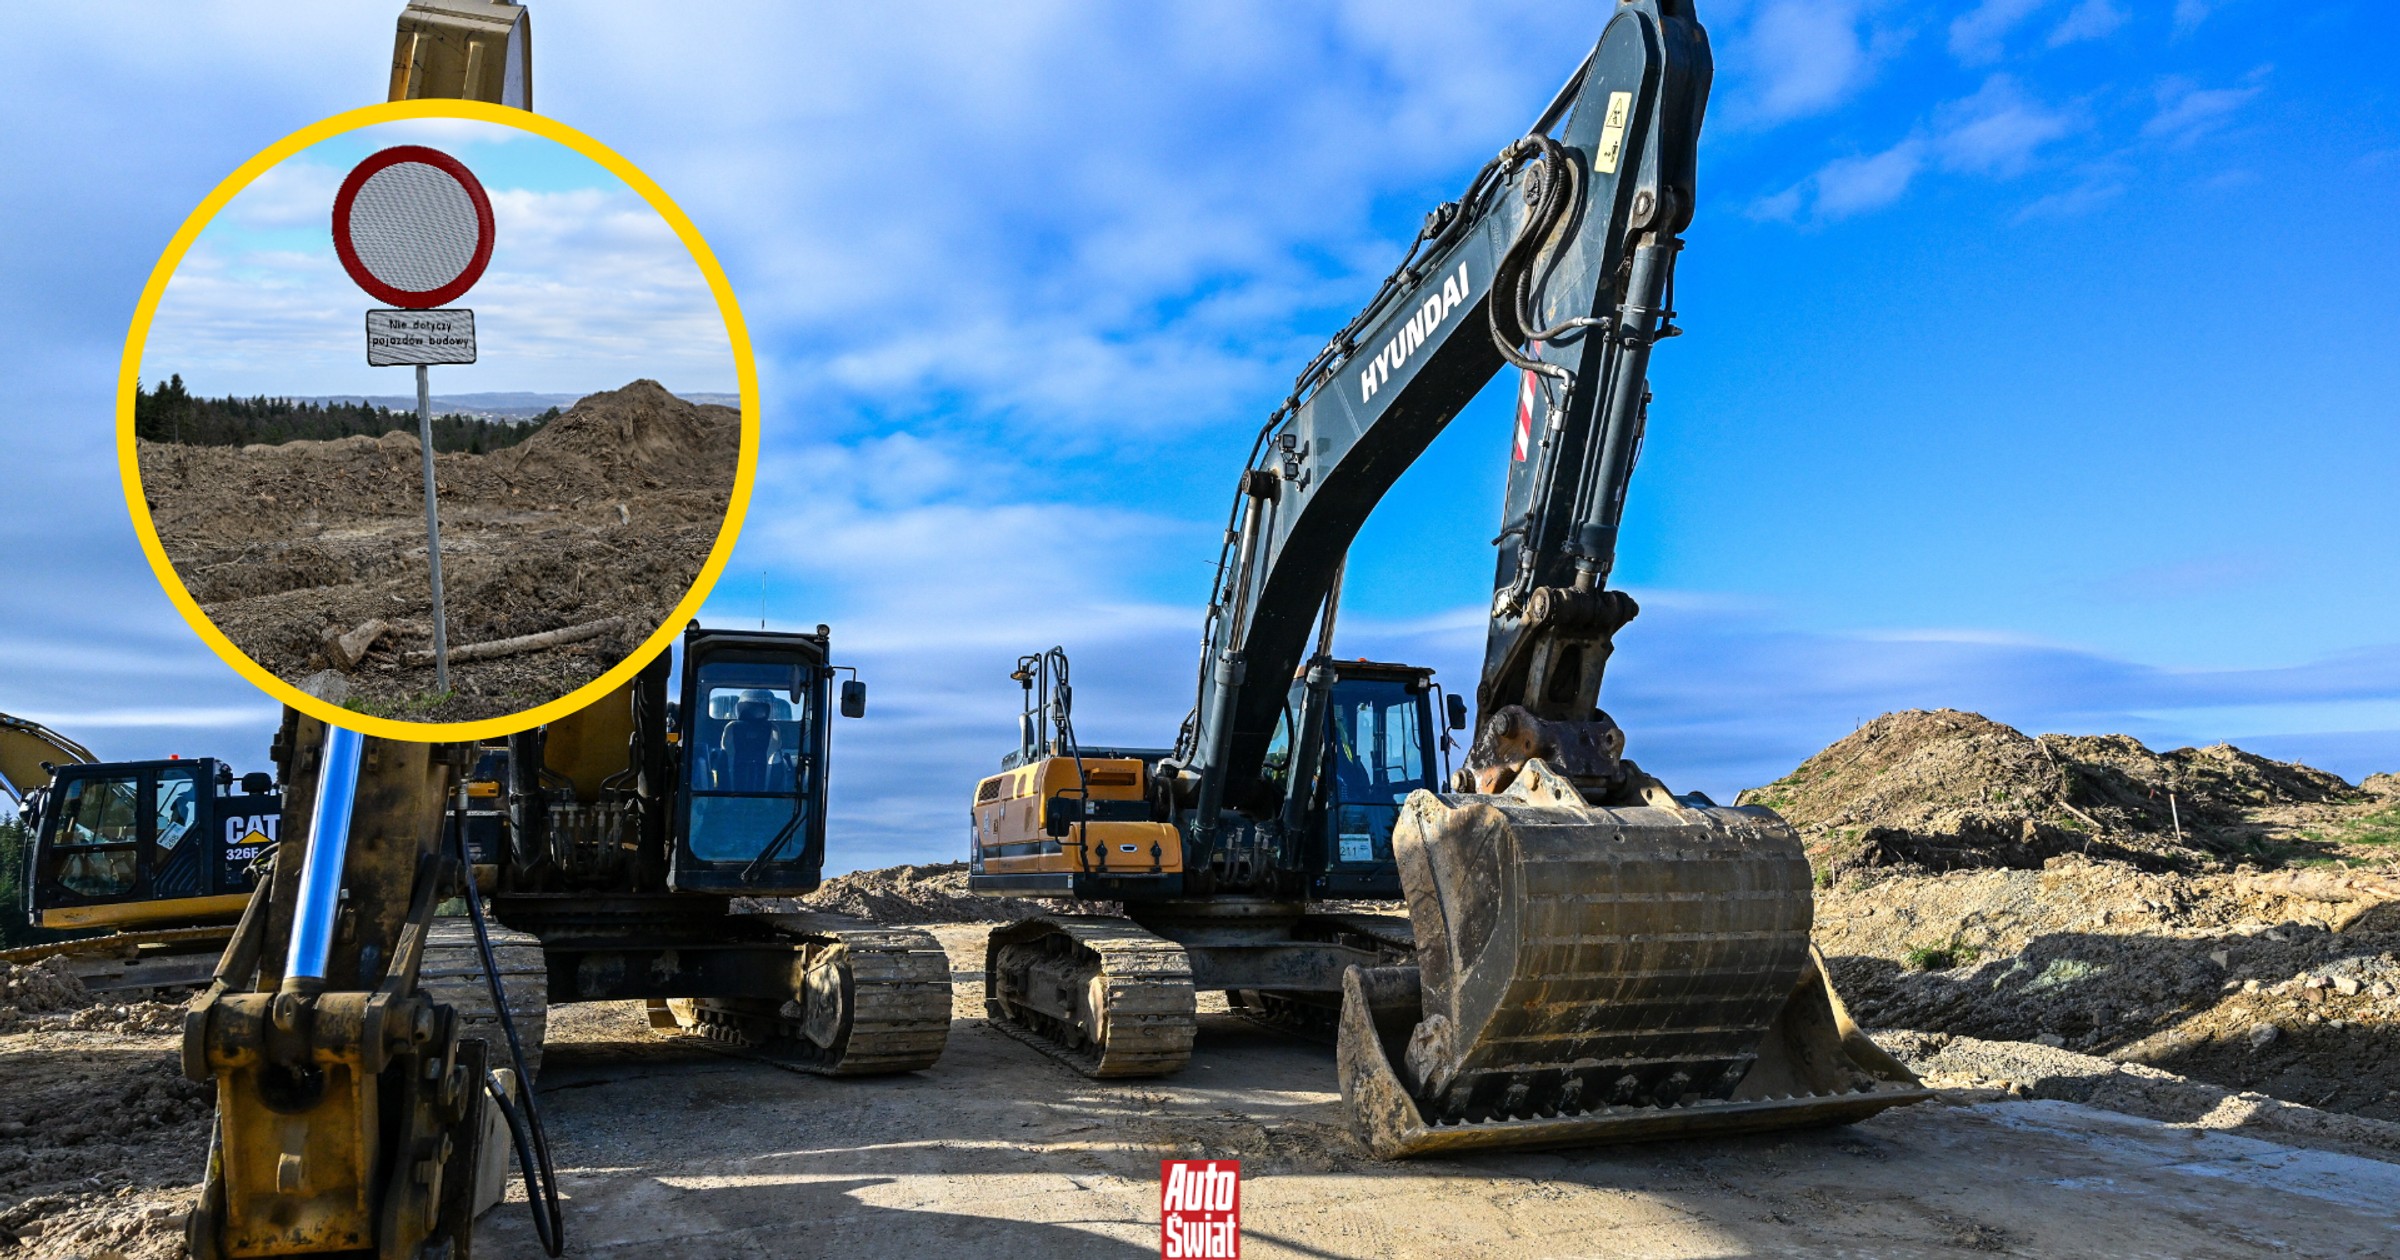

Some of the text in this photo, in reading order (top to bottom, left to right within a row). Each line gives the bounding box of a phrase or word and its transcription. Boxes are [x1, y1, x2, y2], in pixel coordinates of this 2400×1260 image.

[389, 319, 452, 332] Nie dotyczy
[1360, 260, 1470, 404] HYUNDAI
[372, 335, 469, 349] pojazdów budowy
[226, 814, 280, 844] CAT
